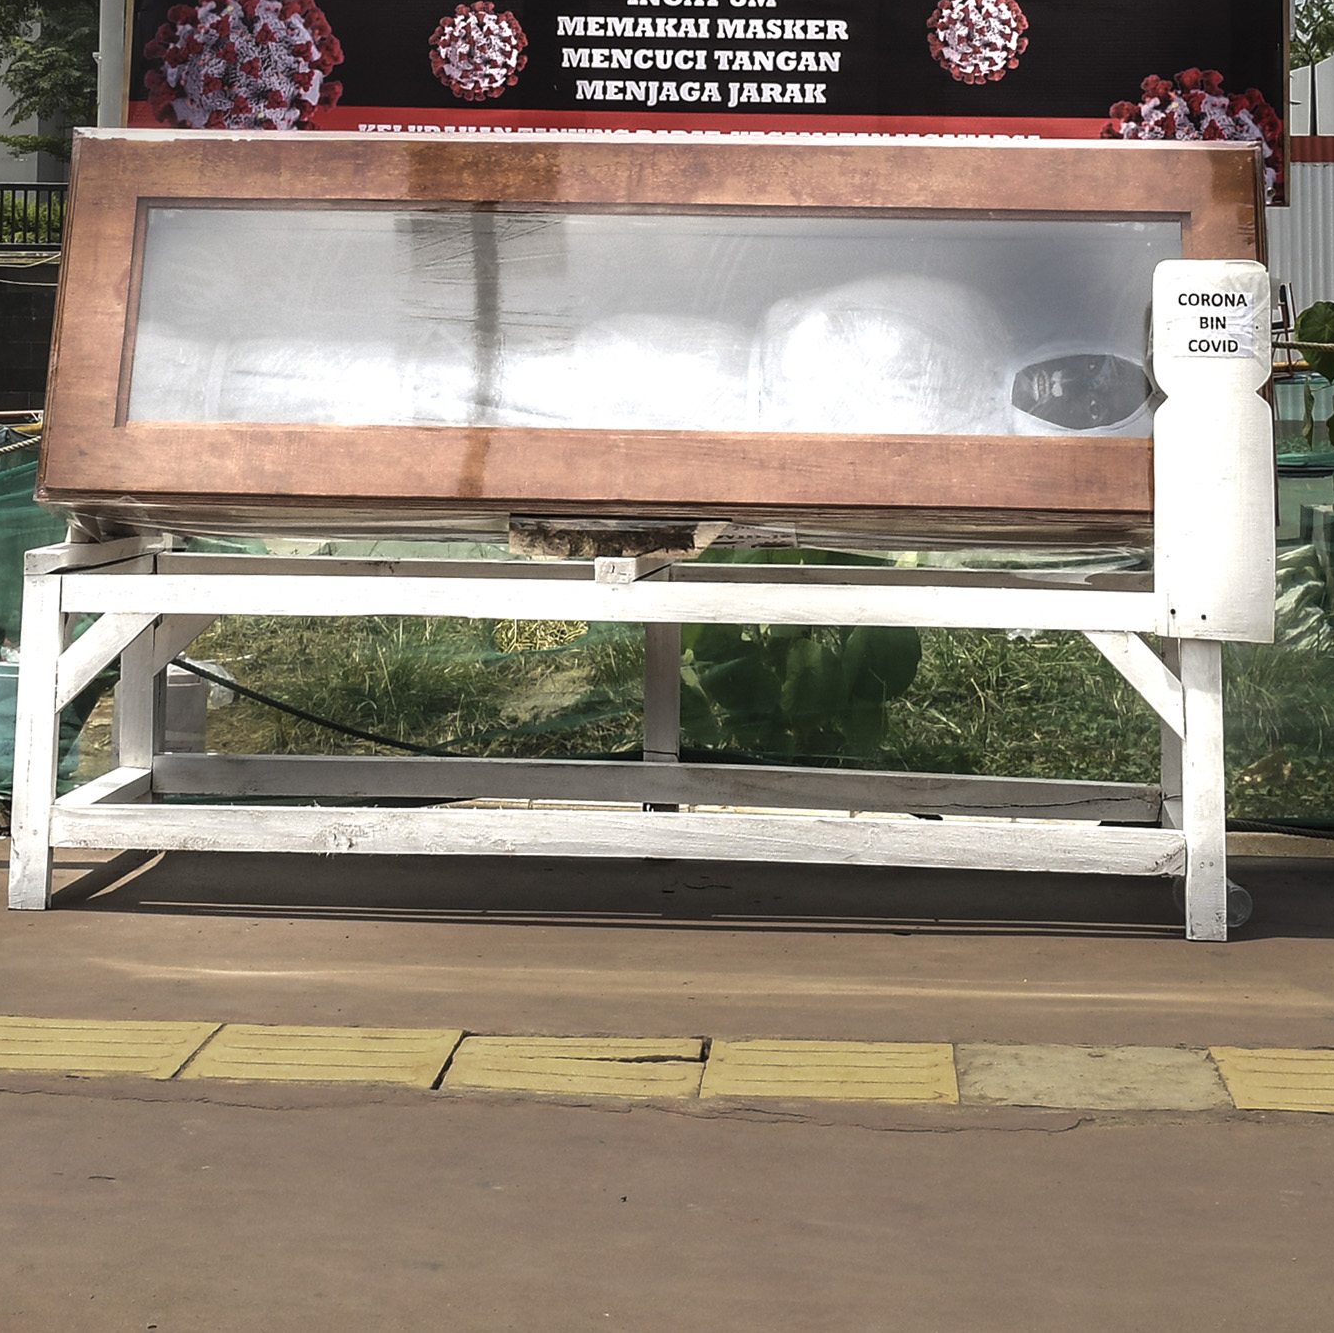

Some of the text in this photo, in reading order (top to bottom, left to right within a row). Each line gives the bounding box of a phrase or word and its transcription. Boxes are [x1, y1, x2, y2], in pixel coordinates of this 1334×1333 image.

[557, 17, 848, 39] MEMAKAI MASKER
[562, 48, 840, 71] MENCUCI TANGAN
[576, 81, 826, 107] MENJAGA JARAK
[1179, 294, 1247, 307] CORONA
[1200, 317, 1226, 329] BIN
[1189, 340, 1238, 352] COVID
